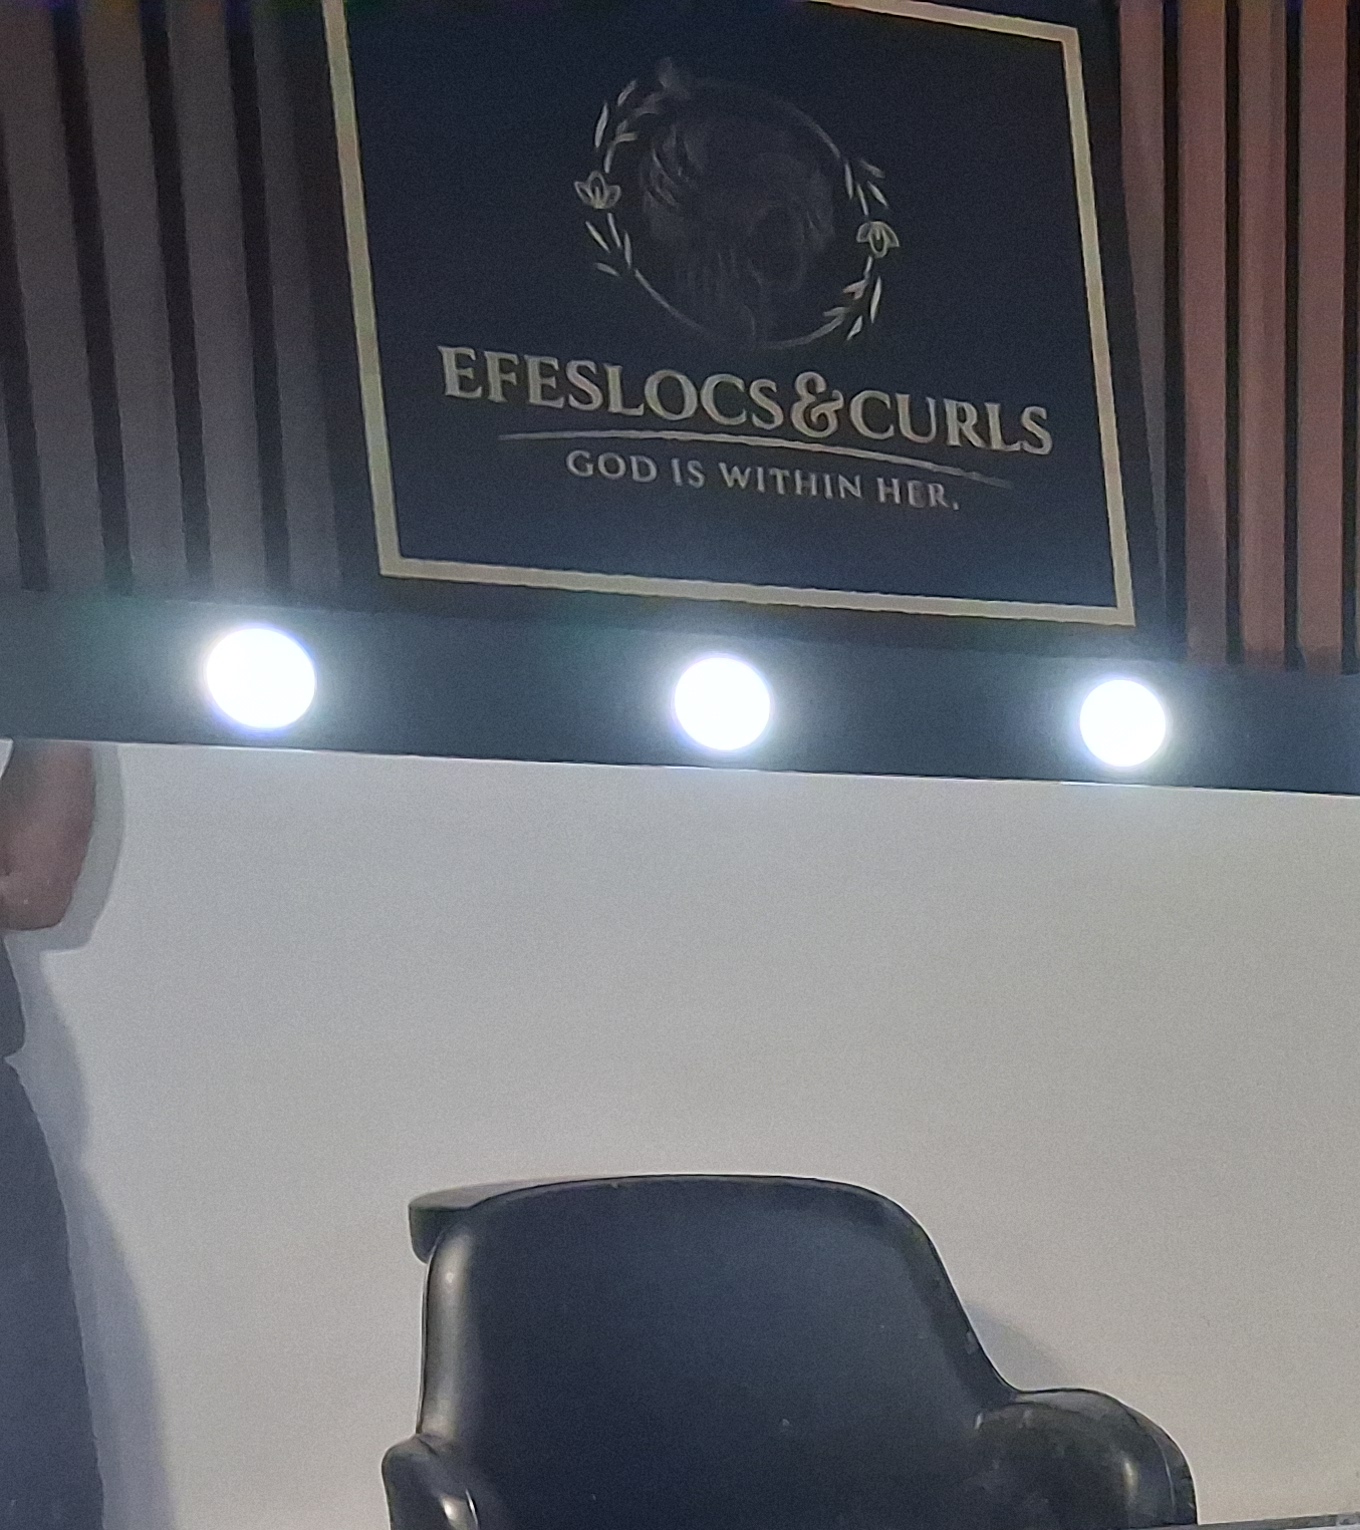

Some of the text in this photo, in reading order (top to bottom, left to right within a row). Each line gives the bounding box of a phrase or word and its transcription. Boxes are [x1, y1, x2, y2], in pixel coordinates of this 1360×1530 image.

[437, 345, 1054, 456] EFESLOCS&CURLS
[566, 449, 961, 512] GOD IS WITHIN HER.
